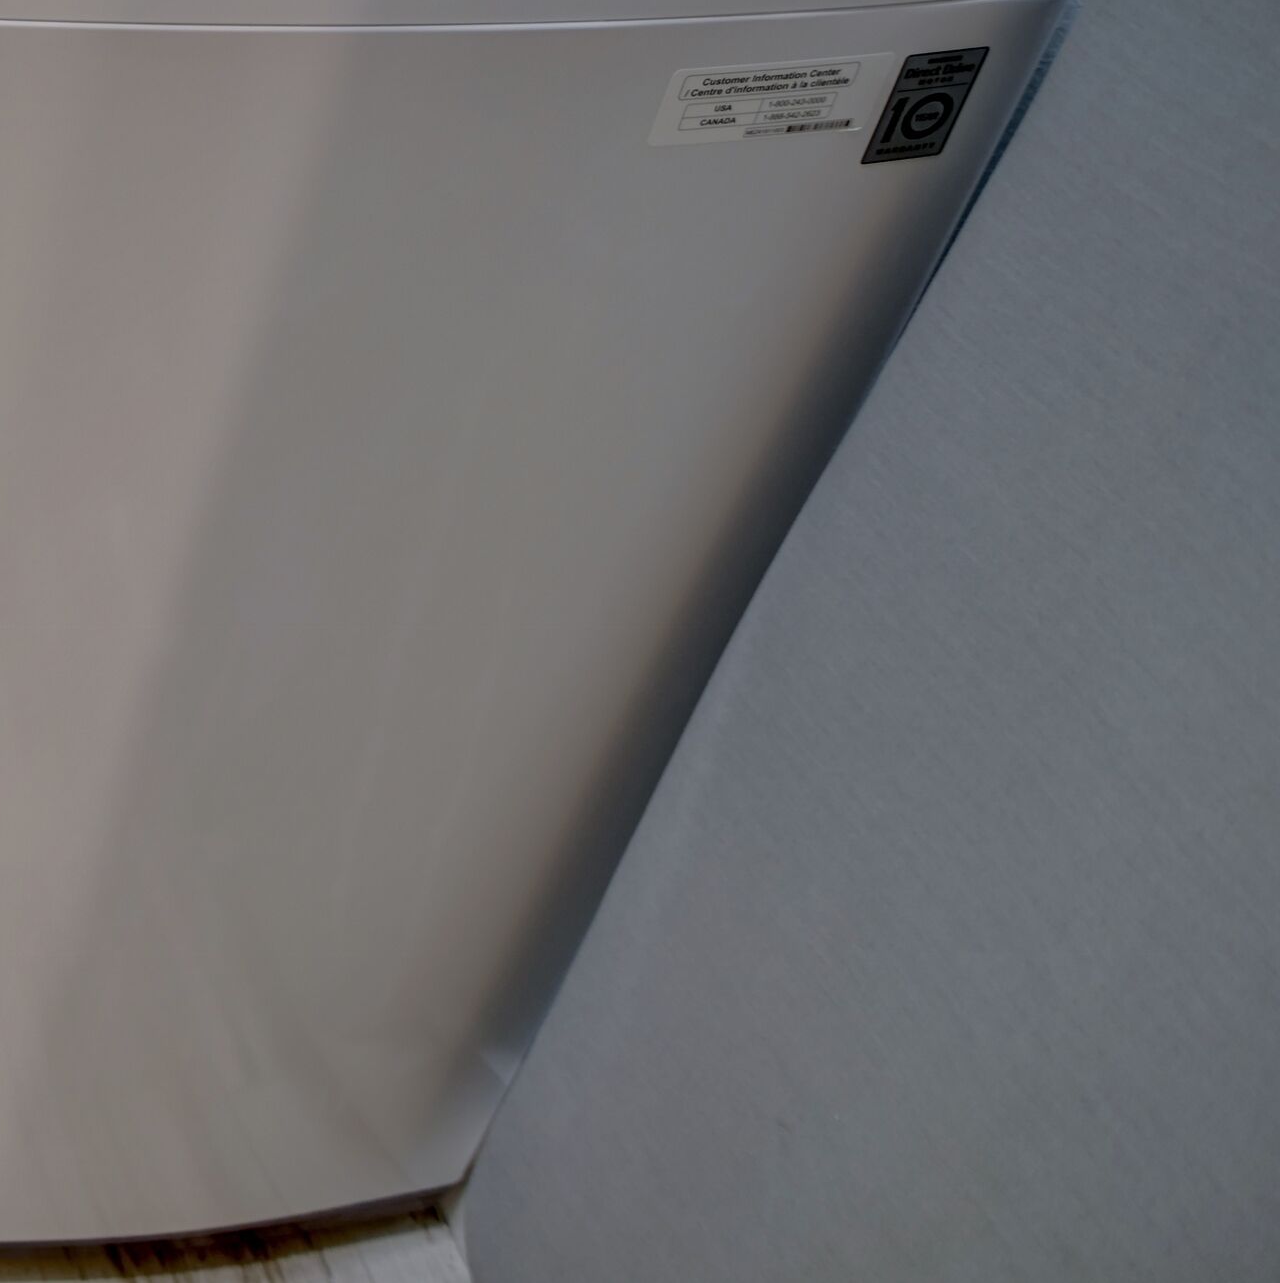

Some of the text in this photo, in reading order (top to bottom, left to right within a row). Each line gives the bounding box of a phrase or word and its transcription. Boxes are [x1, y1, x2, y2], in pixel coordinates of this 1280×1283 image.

[702, 68, 842, 87] Customer Information Center
[691, 87, 723, 97] Centre
[725, 82, 789, 95] d'information
[714, 104, 732, 112] USA
[700, 117, 736, 126] CANADA
[880, 93, 954, 143] 10
